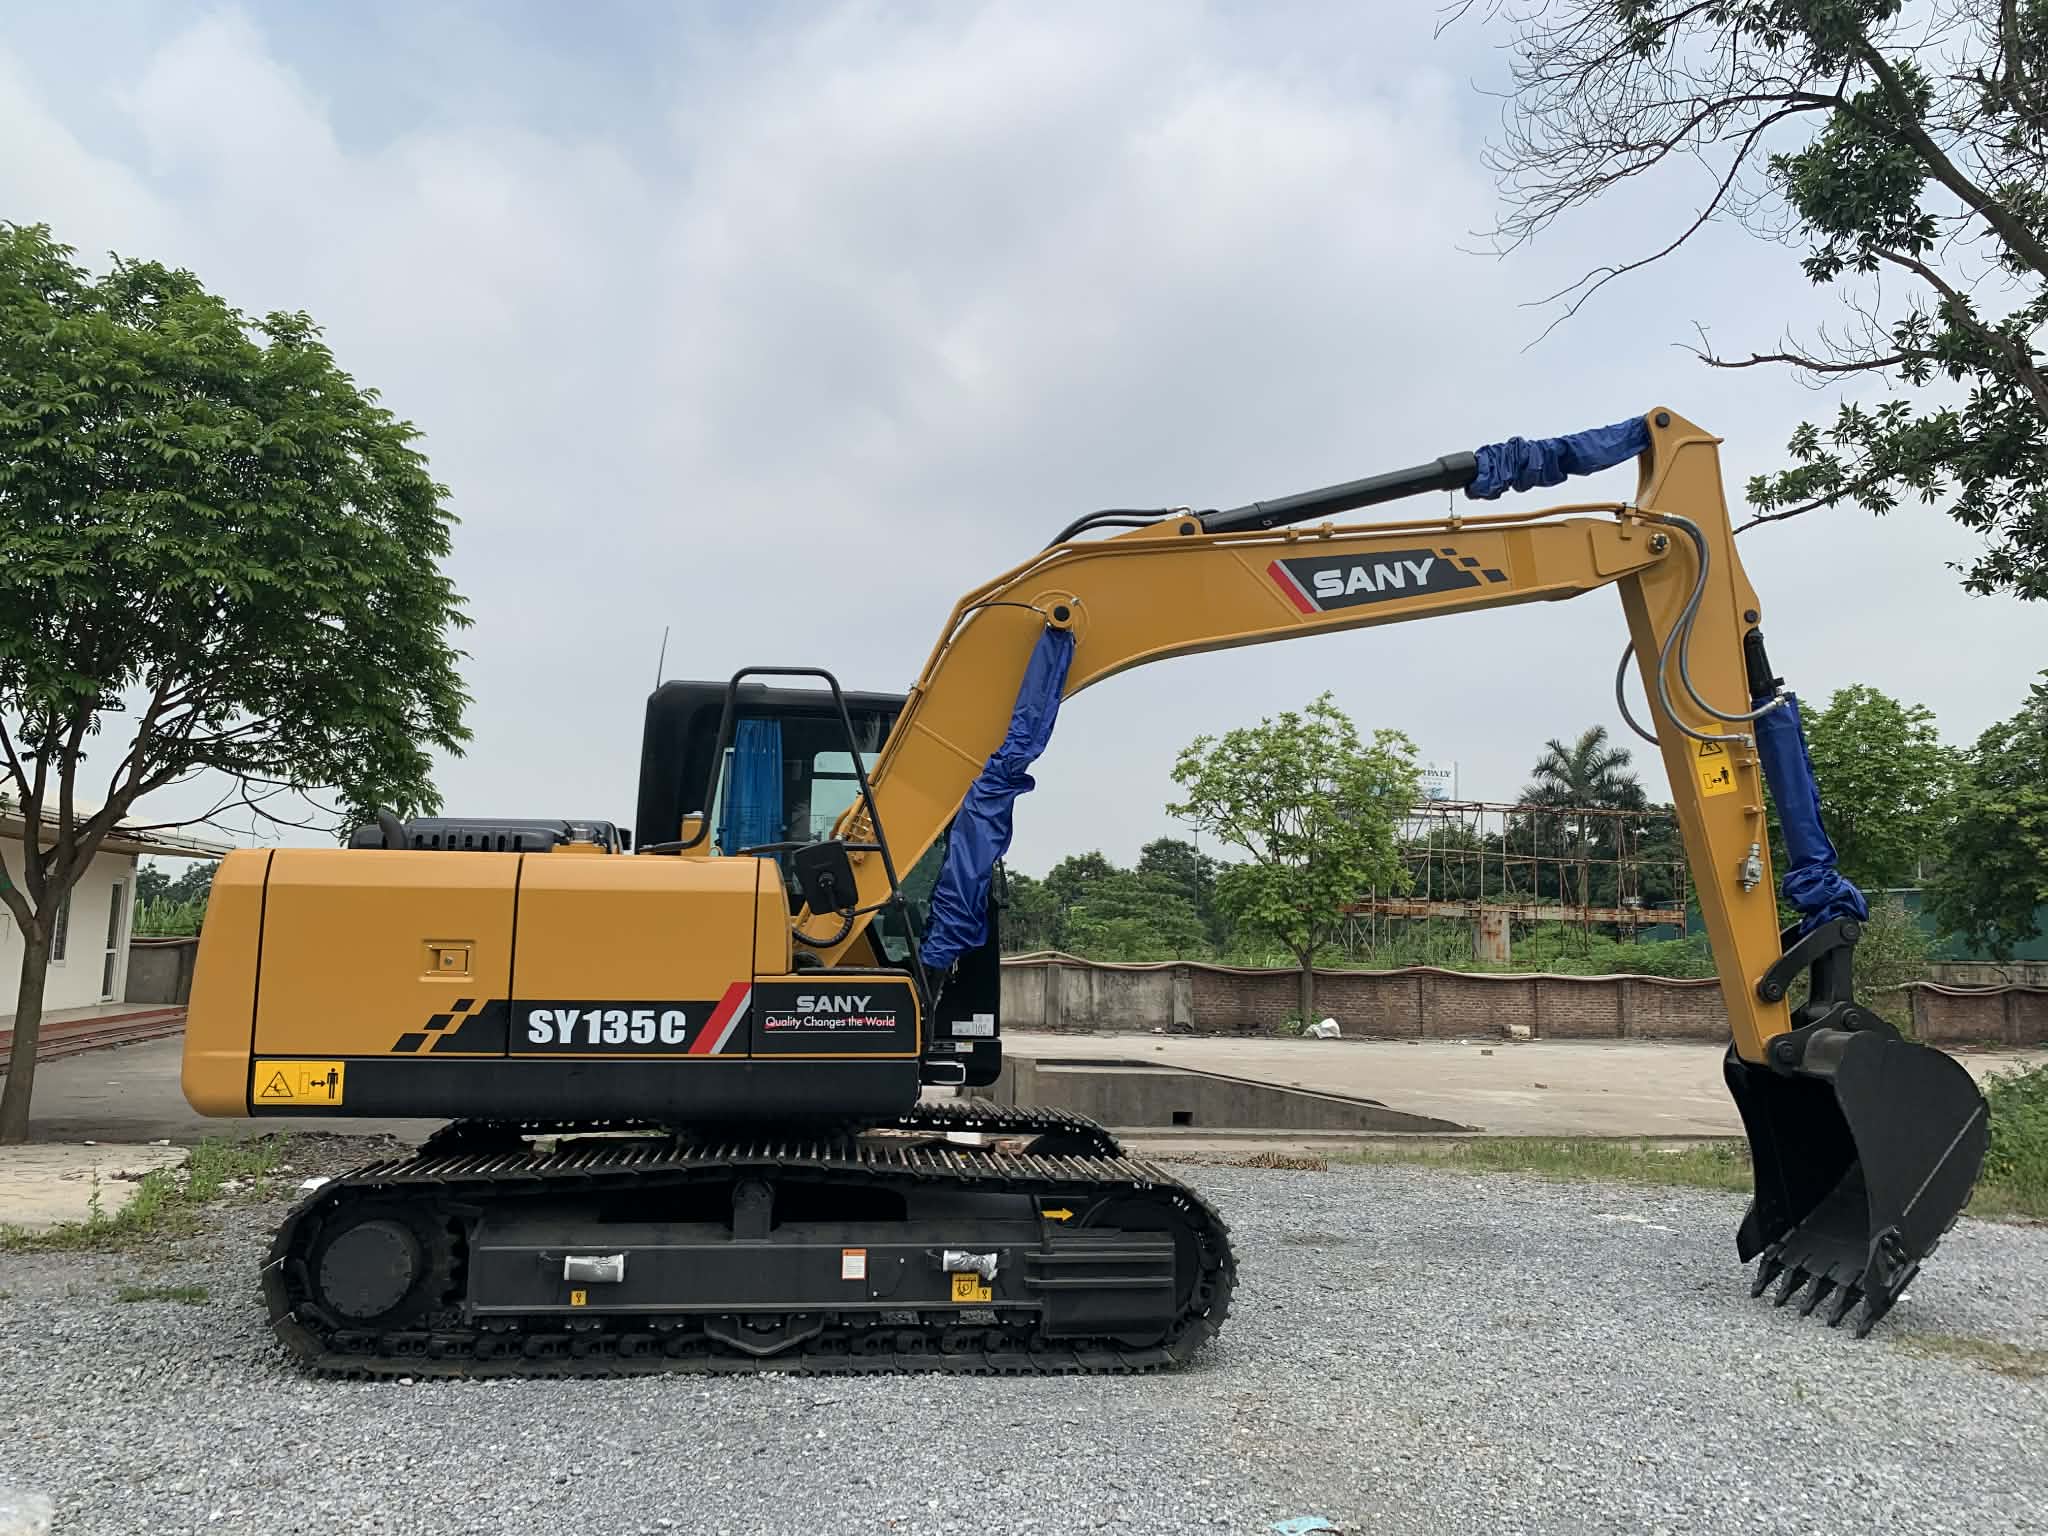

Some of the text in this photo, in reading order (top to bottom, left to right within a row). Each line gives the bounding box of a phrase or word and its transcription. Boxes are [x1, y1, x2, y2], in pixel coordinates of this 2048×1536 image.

[1313, 557, 1435, 599] SANY
[796, 995, 872, 1013] SANY
[528, 1009, 687, 1045] SY135C
[765, 1015, 896, 1030] Quality Changes the World
